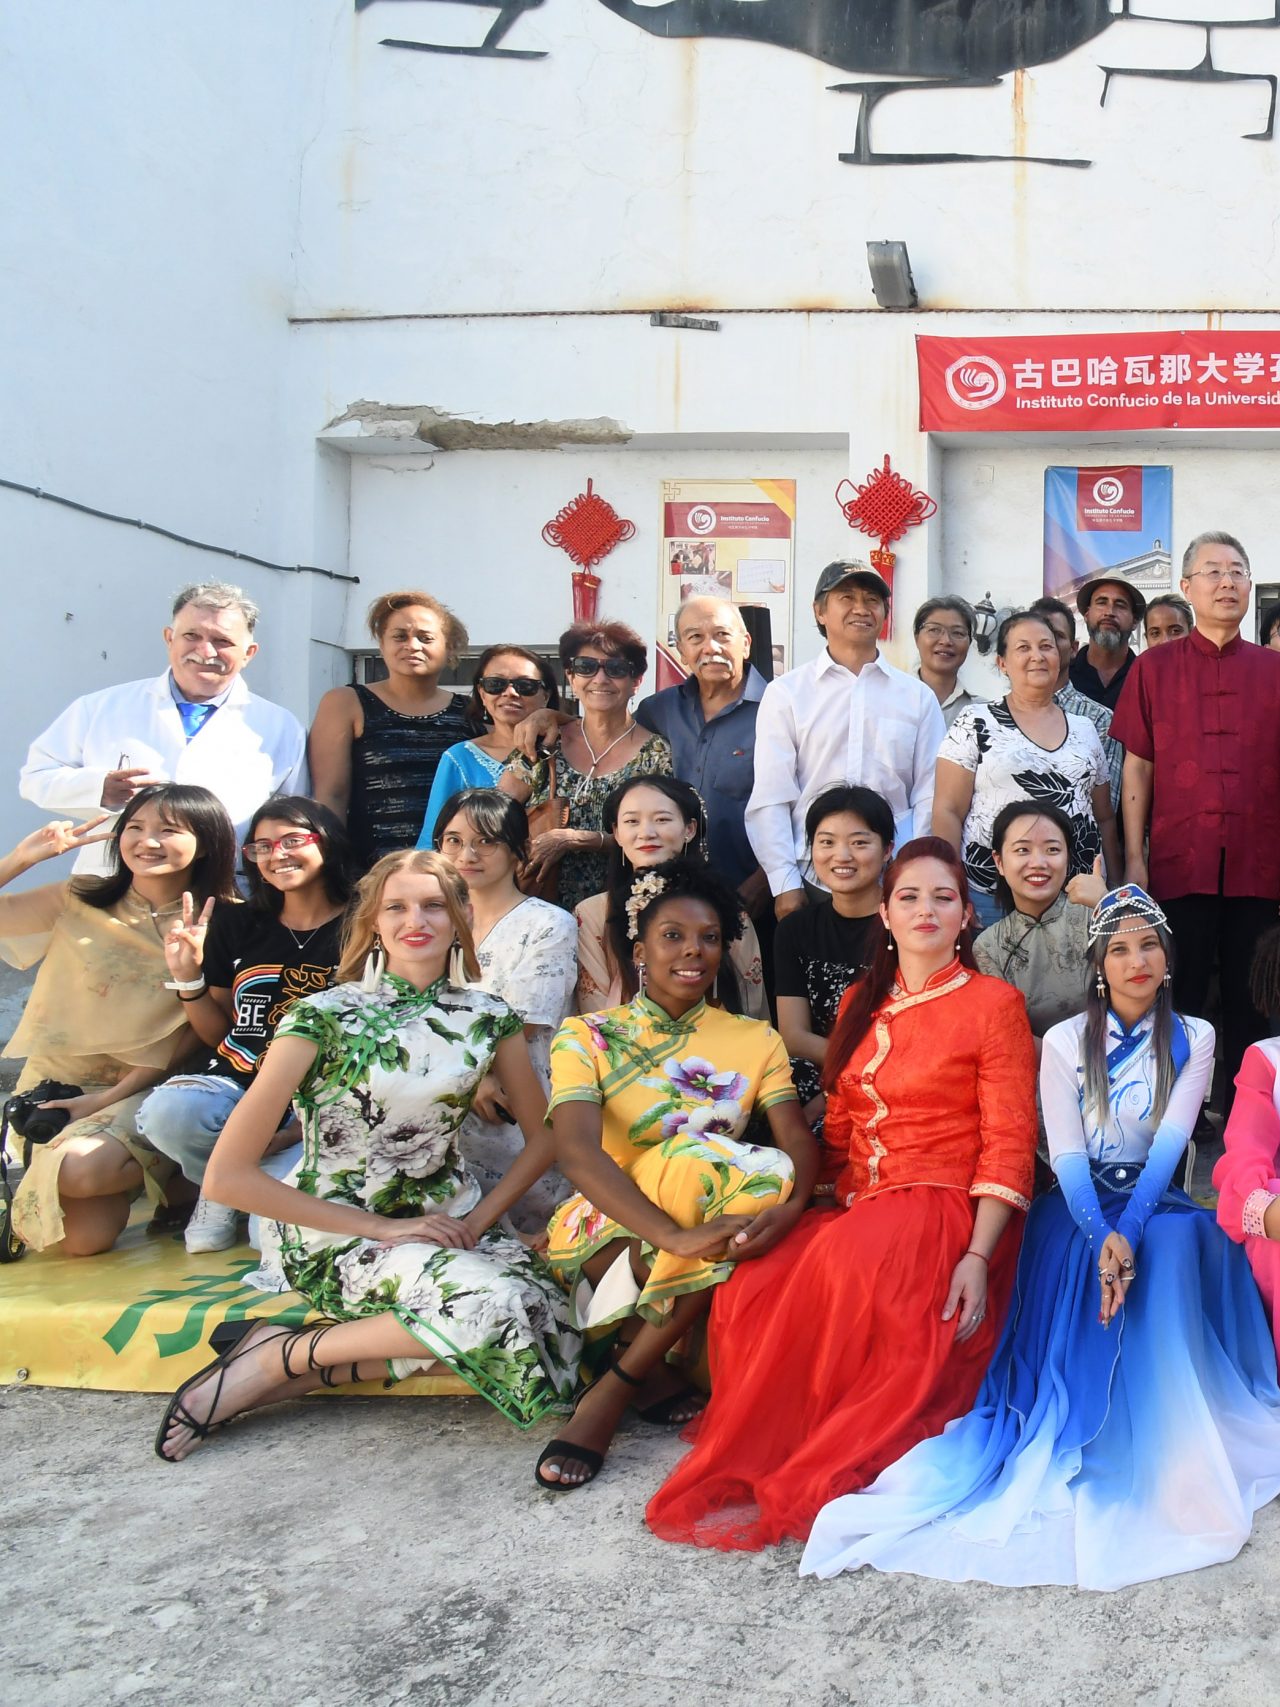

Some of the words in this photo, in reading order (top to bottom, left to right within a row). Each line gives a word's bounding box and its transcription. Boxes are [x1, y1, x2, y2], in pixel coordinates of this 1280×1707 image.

[1016, 394, 1083, 409] Instituto
[1086, 393, 1159, 407] Confucio
[1162, 391, 1183, 405] de
[1187, 392, 1201, 406] la
[237, 1004, 266, 1027] BE
